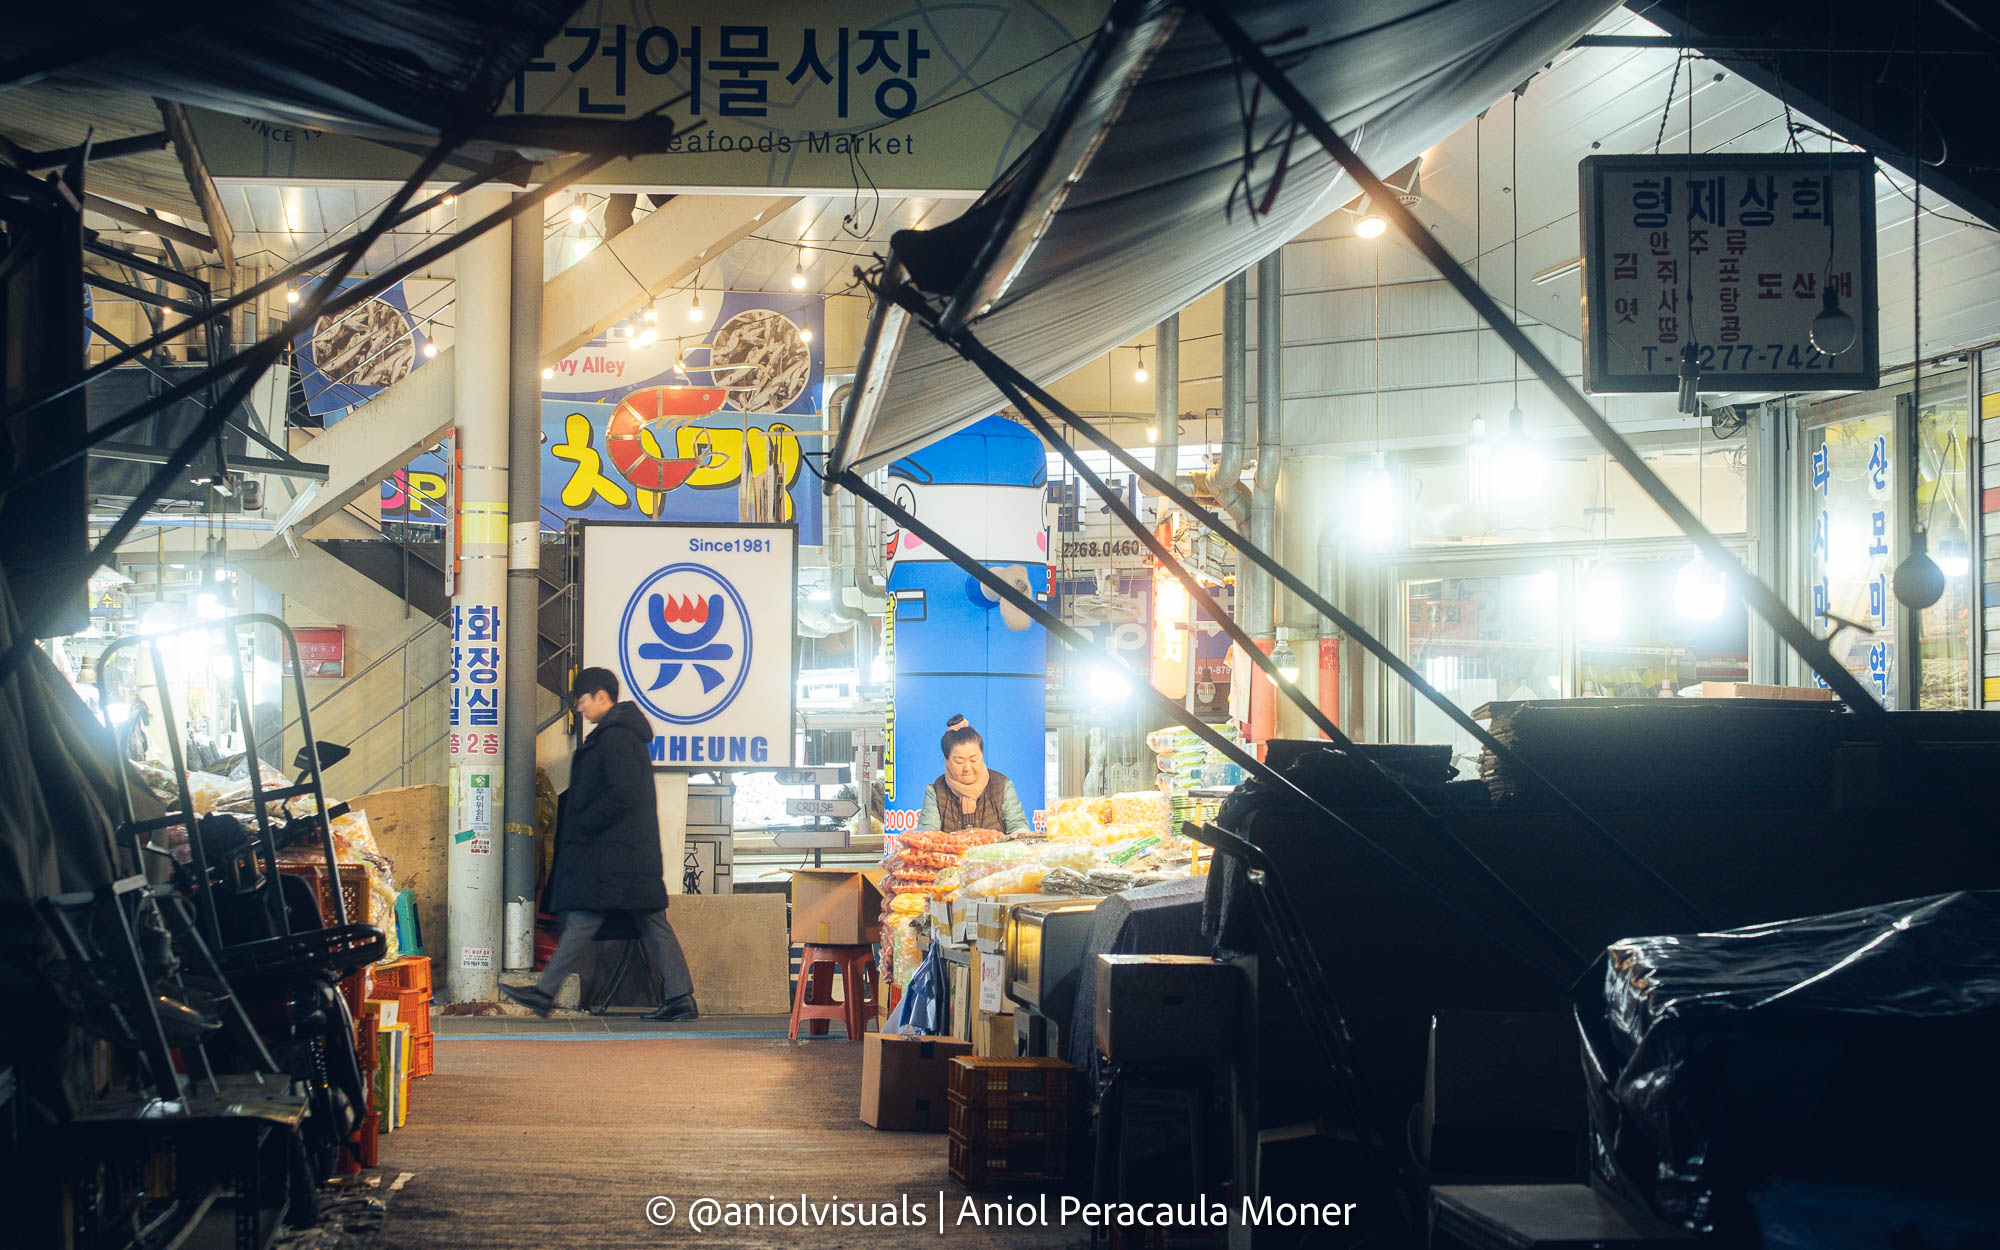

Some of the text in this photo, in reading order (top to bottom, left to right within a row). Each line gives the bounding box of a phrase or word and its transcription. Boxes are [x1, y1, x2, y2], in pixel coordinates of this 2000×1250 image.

[668, 130, 913, 154] eafoods Market
[1632, 175, 1832, 229] 형제상회
[582, 356, 626, 377] Alley
[689, 538, 770, 553] Since1981
[1812, 442, 1831, 690] 다시마
[467, 604, 500, 726] 화장실
[467, 733, 499, 754] 2층
[796, 802, 834, 814] CRUISE
